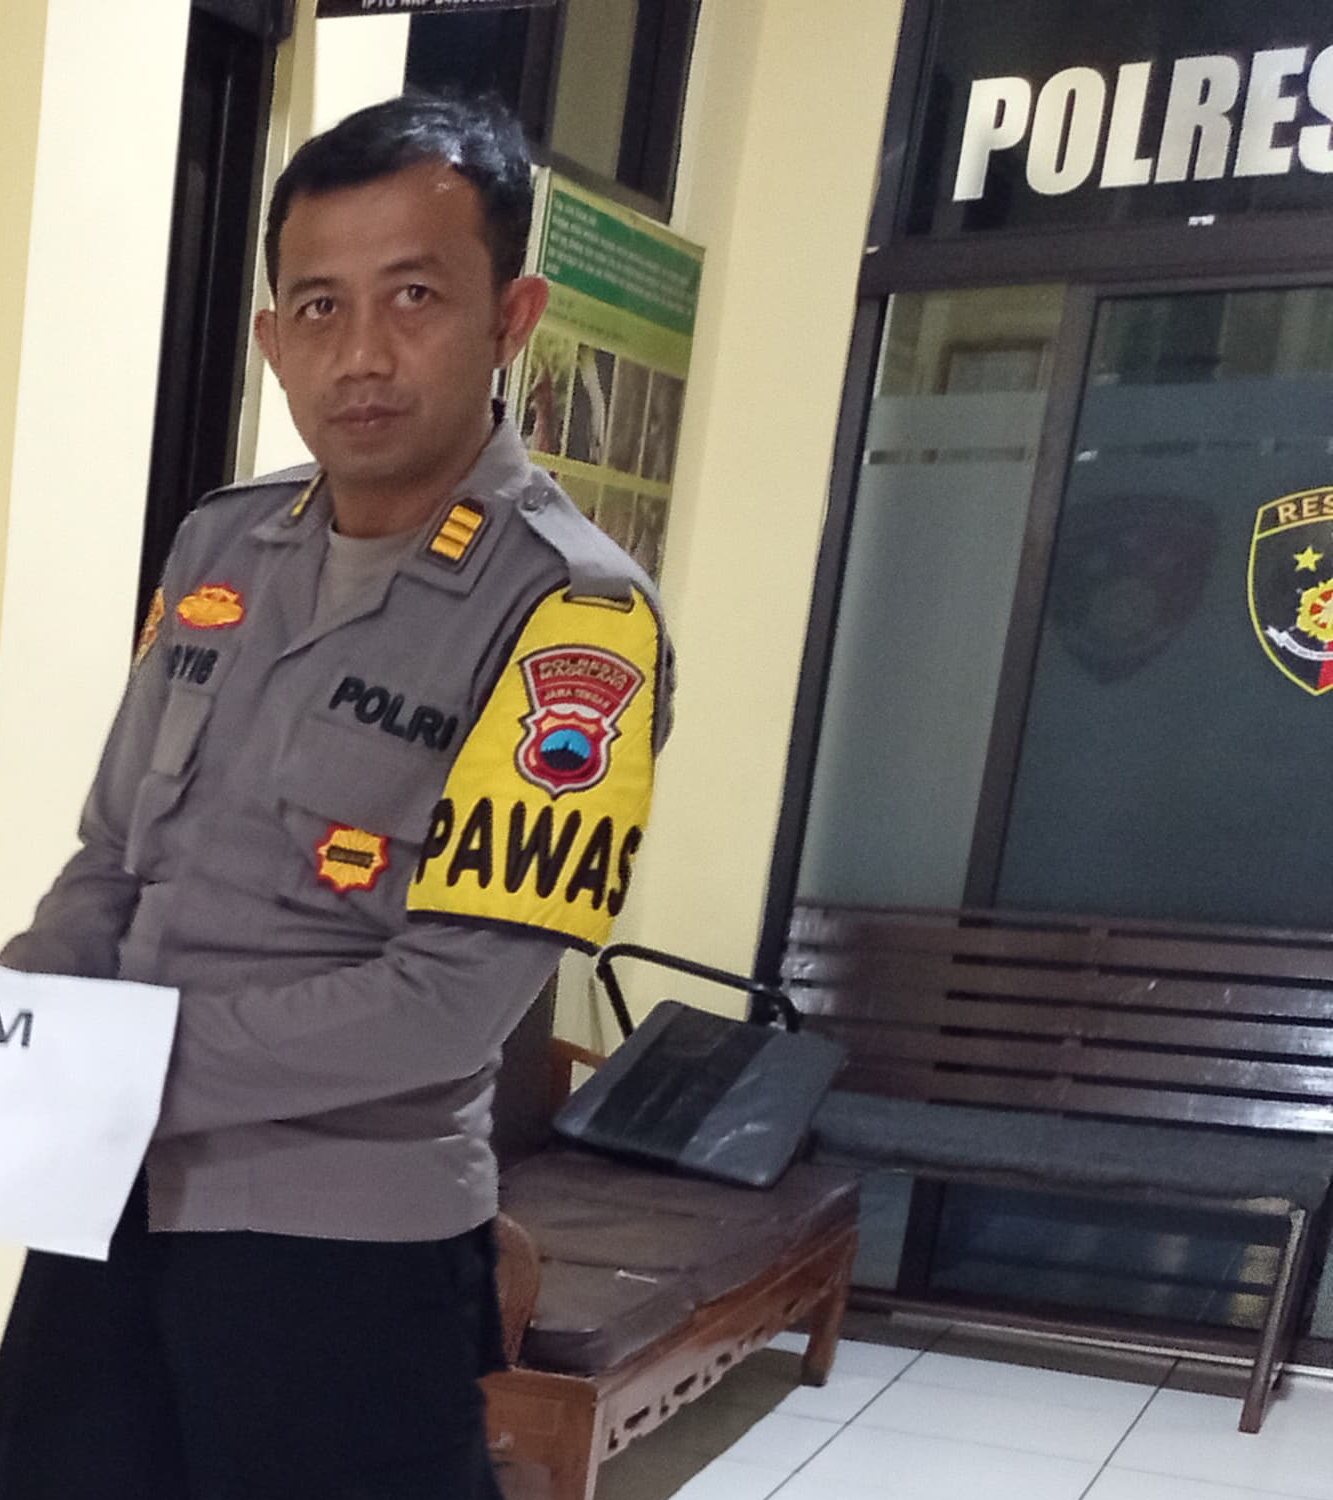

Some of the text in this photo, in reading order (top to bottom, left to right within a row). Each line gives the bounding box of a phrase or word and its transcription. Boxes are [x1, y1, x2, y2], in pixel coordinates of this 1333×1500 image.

[953, 44, 1333, 201] POLRES
[329, 676, 459, 751] POLRI
[416, 797, 643, 917] PAWAS
